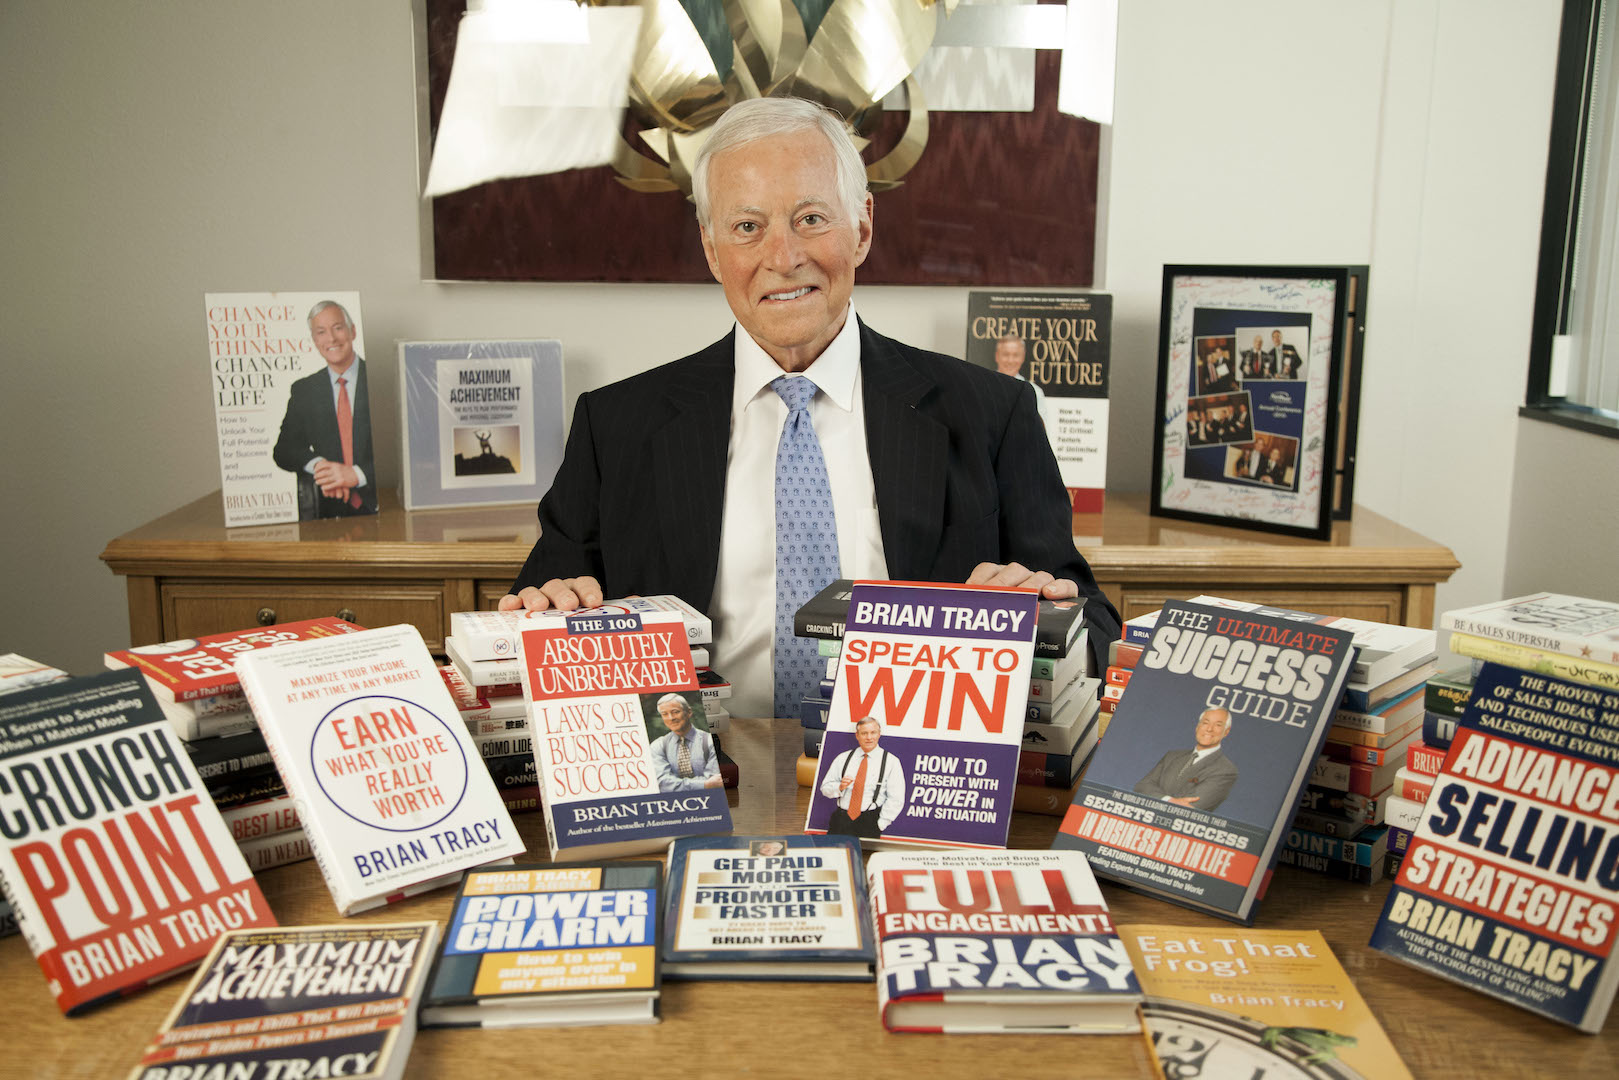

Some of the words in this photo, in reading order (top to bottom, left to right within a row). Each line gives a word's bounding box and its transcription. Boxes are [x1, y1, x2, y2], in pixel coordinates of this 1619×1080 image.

[209, 305, 296, 322] CHANGE
[211, 324, 268, 339] YOUR
[972, 317, 1042, 340] CREATE
[1046, 318, 1099, 342] YOUR
[211, 338, 312, 356] THINKING
[1032, 340, 1080, 363] OWN
[215, 356, 302, 372] CHANGE
[459, 369, 511, 385] MAXIMUM
[1029, 361, 1103, 385] FUTURE
[217, 373, 274, 390] YOUR
[450, 386, 521, 403] ACHIEVEMENT
[219, 390, 266, 407] LIFE
[222, 439, 236, 447] Full
[238, 438, 269, 446] Potential
[236, 450, 268, 458] Success
[225, 472, 272, 481] Achievement
[226, 493, 258, 509] BRIAN
[259, 491, 294, 507] TRACY
[571, 619, 604, 632] THE
[608, 617, 638, 631] 100
[806, 624, 833, 634] CRACKING
[855, 602, 934, 628] BRIAN
[941, 606, 1027, 633] TRACY
[1167, 608, 1212, 631] THE
[1216, 616, 1339, 655] ULTIMATE
[1454, 619, 1466, 631] BE
[1468, 621, 1475, 632] A
[1476, 623, 1504, 639] SALES
[1505, 628, 1561, 651] SUPERSTAR
[541, 632, 674, 666] ABSOLUTELY
[845, 639, 962, 670] SPEAK
[972, 647, 1020, 673] TO
[290, 671, 339, 688] MAXIMIZE
[341, 666, 368, 679] YOUR
[370, 660, 407, 673] INCOME
[536, 659, 691, 695] UNBREAKABLE
[1143, 626, 1333, 701] SUCCESS
[183, 689, 199, 699] Eat
[199, 687, 221, 697] That
[286, 694, 297, 704] AT
[301, 690, 321, 701] ANY
[323, 684, 347, 697] TIME
[349, 681, 361, 691] IN
[363, 677, 382, 689] ANY
[383, 669, 422, 685] MARKET
[845, 665, 1010, 734] WIN
[1520, 675, 1547, 692] THE
[1547, 682, 1603, 705] PROVEN
[1205, 685, 1313, 728] GUIDE
[1475, 697, 1505, 714] AND
[1507, 704, 1589, 737] TECHNIQUES
[1493, 685, 1514, 699] OF
[1513, 690, 1554, 710] SALES
[1554, 700, 1597, 723] IDEAS,
[331, 705, 419, 751] EARN
[541, 702, 606, 735] LAWS
[611, 702, 637, 725] OF
[1479, 714, 1568, 748] SALESPEOPLE
[325, 751, 380, 778] WHAT
[384, 734, 448, 766] YOU'RE
[482, 739, 510, 757] CÓMO
[546, 730, 644, 766] BUSINESS
[198, 762, 228, 779] SECRET
[229, 758, 241, 772] TO
[365, 761, 433, 796] REALLY
[553, 761, 650, 798] SUCCESS
[915, 755, 961, 774] HOW
[964, 758, 988, 777] TO
[912, 773, 966, 788] PRESENT
[968, 777, 999, 791] WITH
[373, 786, 445, 819] WORTH
[573, 803, 639, 823] BRIAN
[640, 796, 711, 815] TRACY
[910, 787, 979, 808] POWER
[981, 798, 995, 810] IN
[1112, 790, 1122, 800] THE
[1122, 792, 1145, 805] WORLD'S
[1145, 798, 1167, 813] LEADING
[1166, 803, 1190, 819] EXPERTS
[1190, 810, 1210, 824] REVEAL
[1211, 815, 1228, 828] THEIR
[233, 813, 270, 841] BEST
[567, 828, 593, 837] Author
[594, 825, 603, 833] of
[603, 824, 614, 832] the
[615, 822, 646, 831] bestseller
[646, 818, 682, 828] Maximum
[682, 814, 723, 825] Achievement
[906, 805, 933, 819] ANY
[935, 807, 997, 824] SITUATION
[1083, 794, 1155, 824] SECRETS
[1154, 816, 1173, 828] FOR
[1171, 817, 1249, 850] SUCCESS
[354, 839, 429, 878] BRIAN
[430, 818, 502, 855] TRACY
[11, 795, 202, 941] POINT
[475, 872, 530, 884] BRIAN
[534, 870, 592, 882] TRACY
[713, 858, 759, 871] GET
[765, 856, 823, 870] PAID
[732, 870, 806, 884] MORE
[1097, 846, 1140, 866] FEATURING
[1140, 857, 1166, 873] BRIAN
[1167, 865, 1195, 881] TRACY
[882, 869, 1109, 912] FULL
[1111, 860, 1134, 876] Experts
[1134, 868, 1148, 880] from
[1149, 872, 1172, 886] Around
[1173, 880, 1184, 890] the
[1184, 883, 1204, 896] World
[462, 890, 649, 924] POWER
[695, 889, 841, 904] PROMOTED
[1406, 844, 1615, 947] STRATEGIES
[719, 904, 817, 919] FASTER
[884, 912, 1114, 934] ENGAGEMENT!
[62, 924, 165, 987] BRIAN
[160, 890, 258, 949] TRACY
[454, 915, 646, 951] CHARM
[712, 936, 764, 945] BRIAN
[769, 934, 823, 944] TRACY
[1388, 891, 1485, 951] BRIAN
[1488, 925, 1598, 992] TRACY
[215, 938, 420, 971] MAXIMUM
[517, 953, 558, 966] How
[563, 952, 582, 964] to
[588, 950, 622, 962] win
[882, 937, 1133, 966] BRIAN
[1137, 935, 1206, 955] Eat
[1213, 938, 1317, 959] That
[498, 966, 567, 980] anyone
[570, 963, 615, 975] over
[620, 962, 637, 973] in
[886, 962, 1136, 991] TRACY
[1143, 954, 1250, 978] Frog!
[190, 962, 413, 1005] ACHIEVEMENT
[500, 979, 535, 992] any
[540, 975, 626, 988] situation
[1209, 992, 1274, 1006] Brian
[1279, 995, 1346, 1011] Tracy
